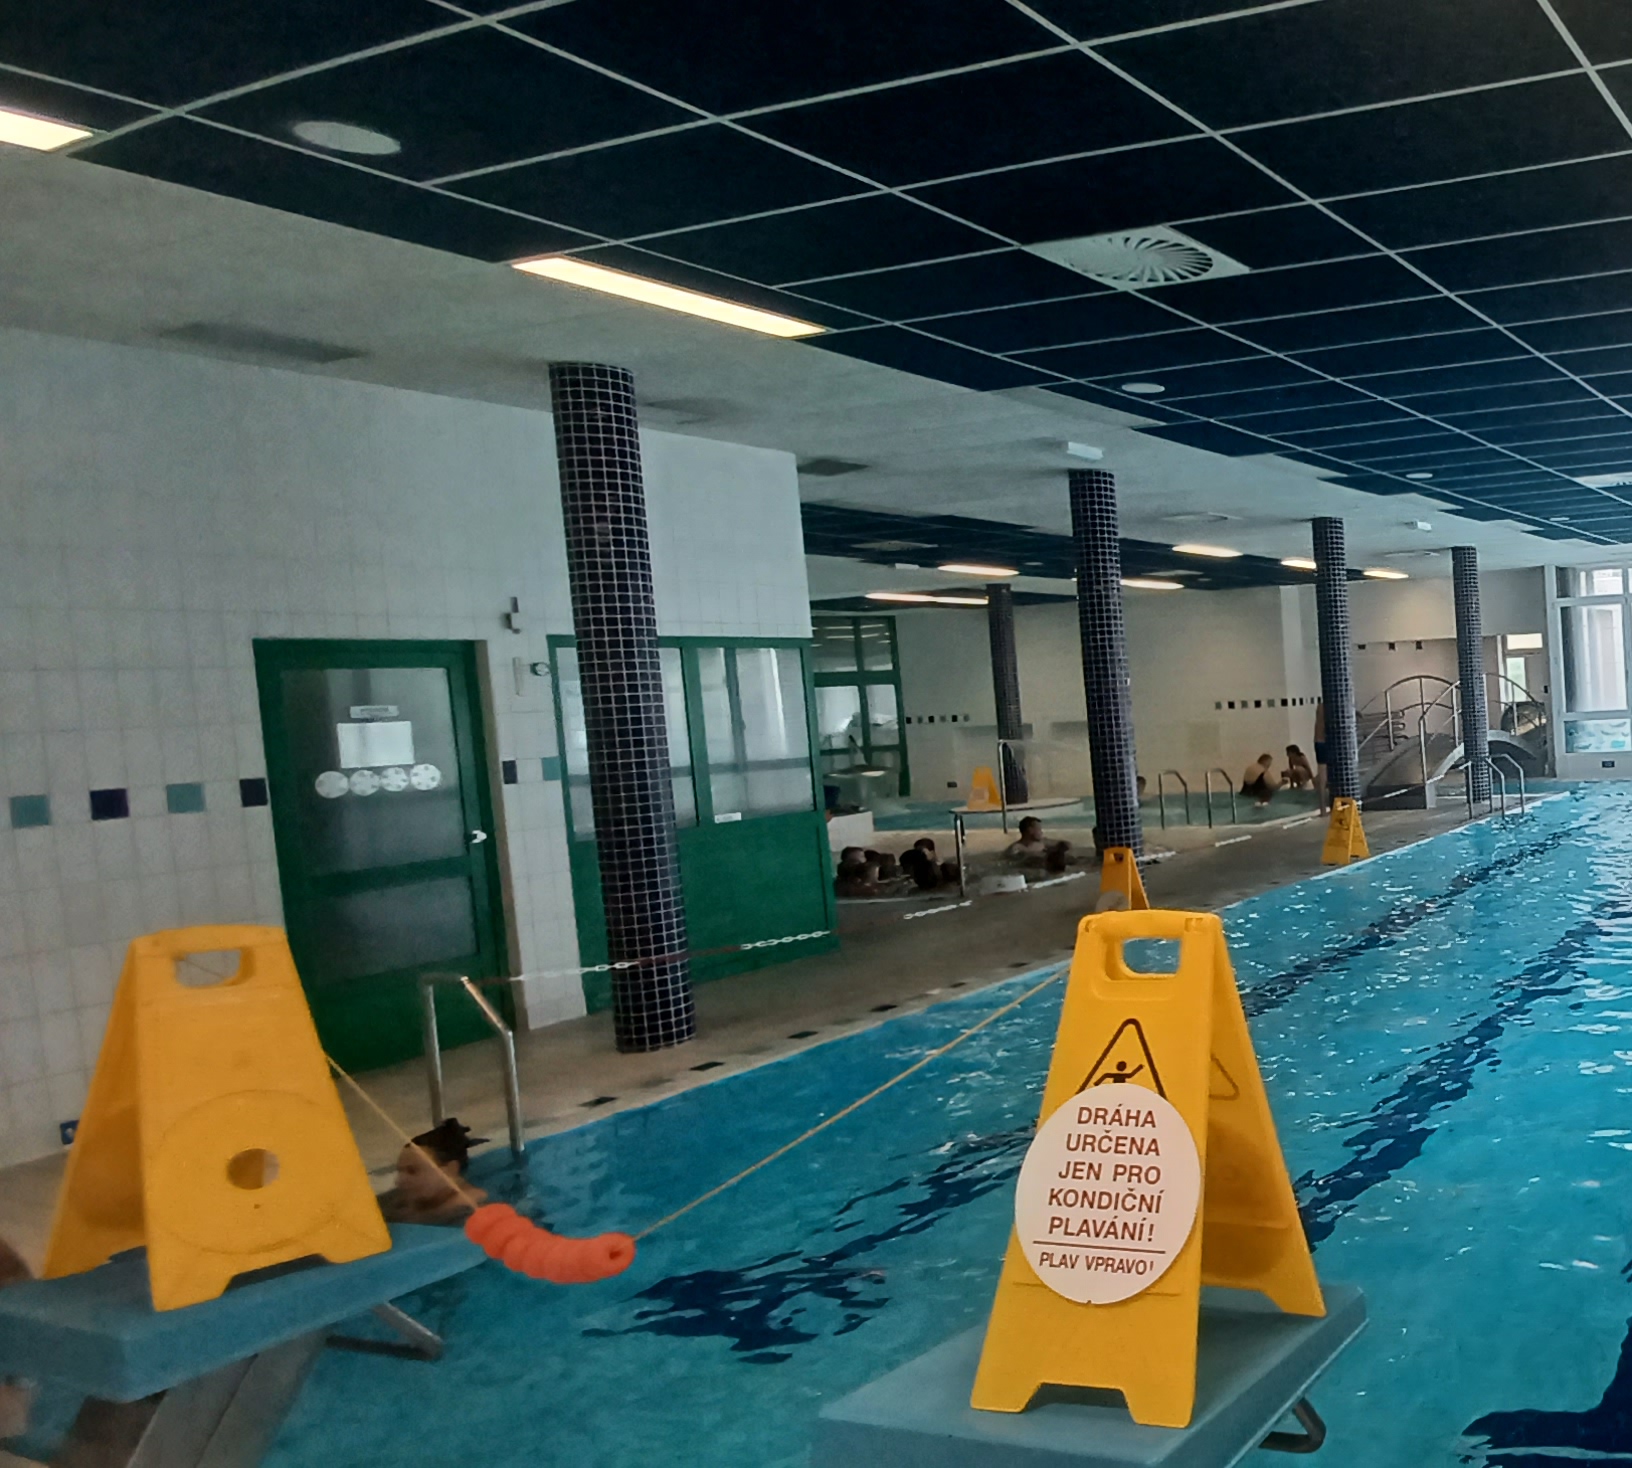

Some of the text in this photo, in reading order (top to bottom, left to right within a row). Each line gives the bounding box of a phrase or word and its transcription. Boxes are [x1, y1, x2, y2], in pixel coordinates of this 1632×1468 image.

[1077, 1103, 1156, 1128] DRÁHA
[1066, 1129, 1161, 1156] URČENA
[1058, 1161, 1161, 1185] JEN PRO
[1048, 1187, 1165, 1214] KONDIČNÍ
[1048, 1215, 1155, 1242] PLAVÁNÍ!
[1039, 1251, 1080, 1269] PLAV
